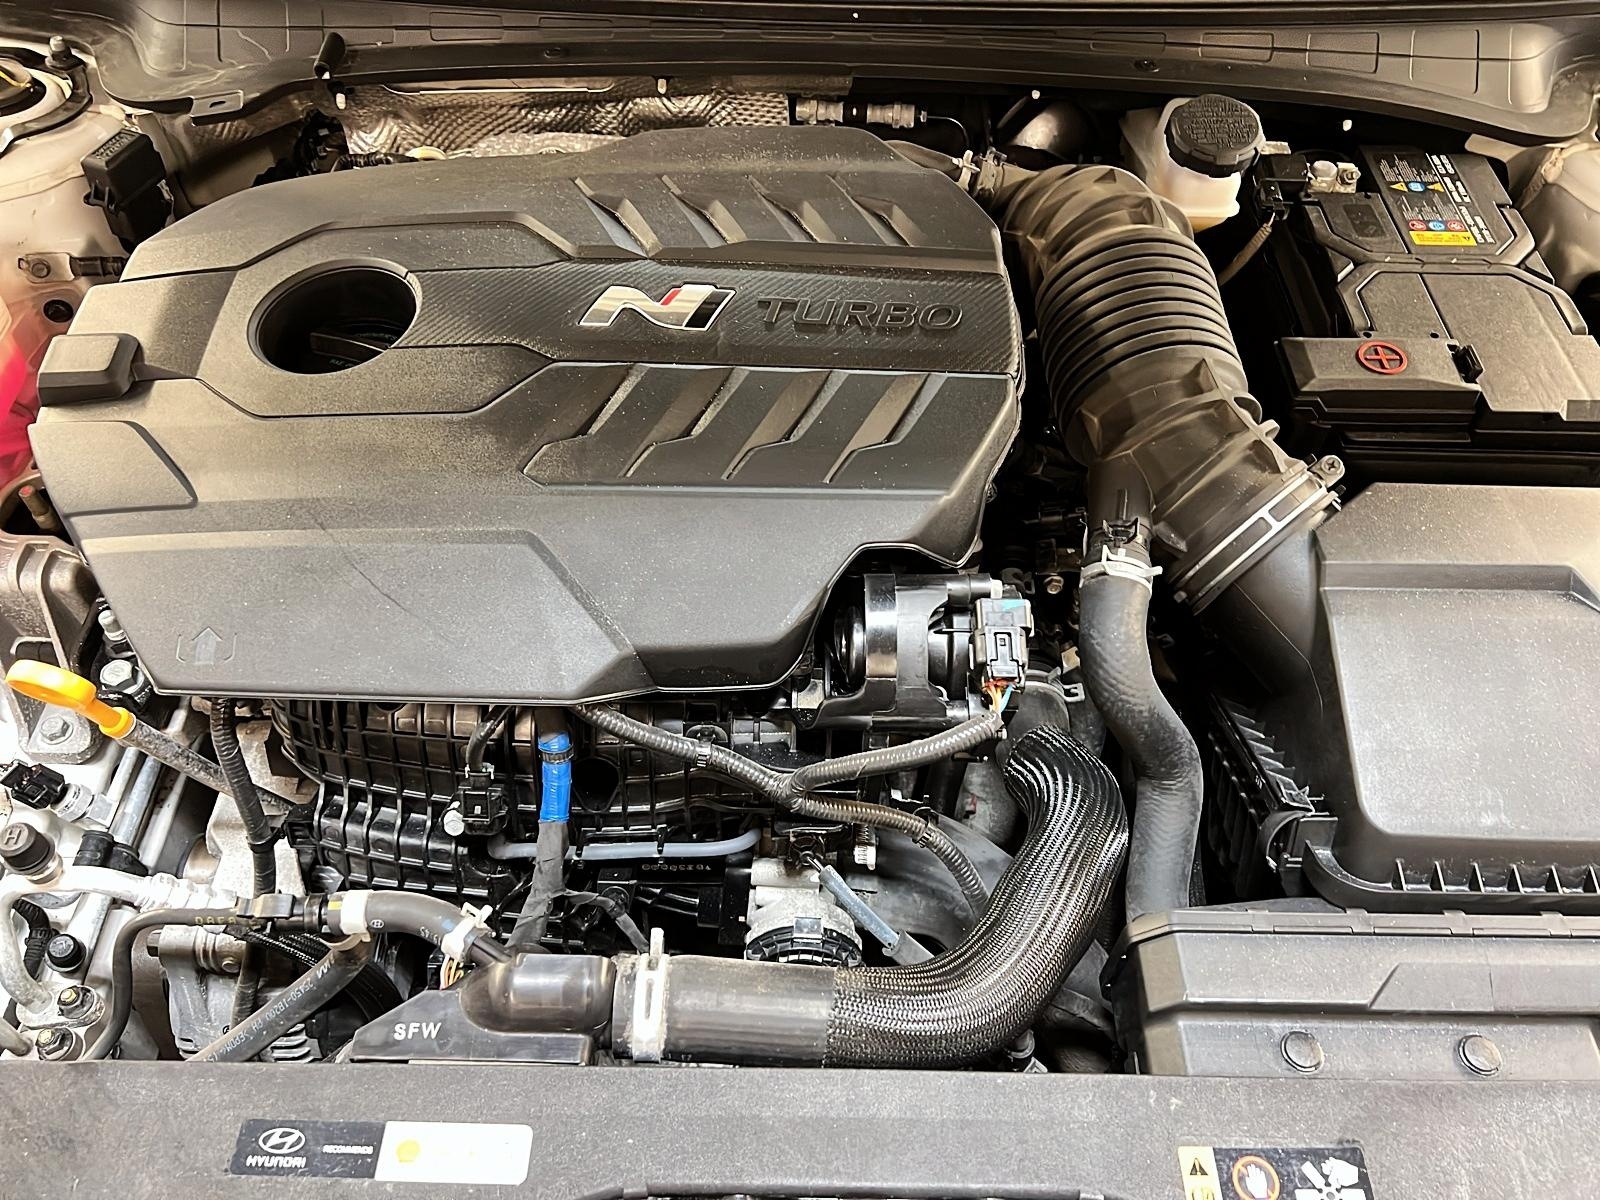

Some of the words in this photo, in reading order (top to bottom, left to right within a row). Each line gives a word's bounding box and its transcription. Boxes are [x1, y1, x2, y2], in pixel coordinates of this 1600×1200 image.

[757, 296, 964, 331] TURBO
[4, 828, 22, 846] H
[393, 1022, 442, 1041] SFW
[246, 1154, 307, 1168] HYUNDAI
